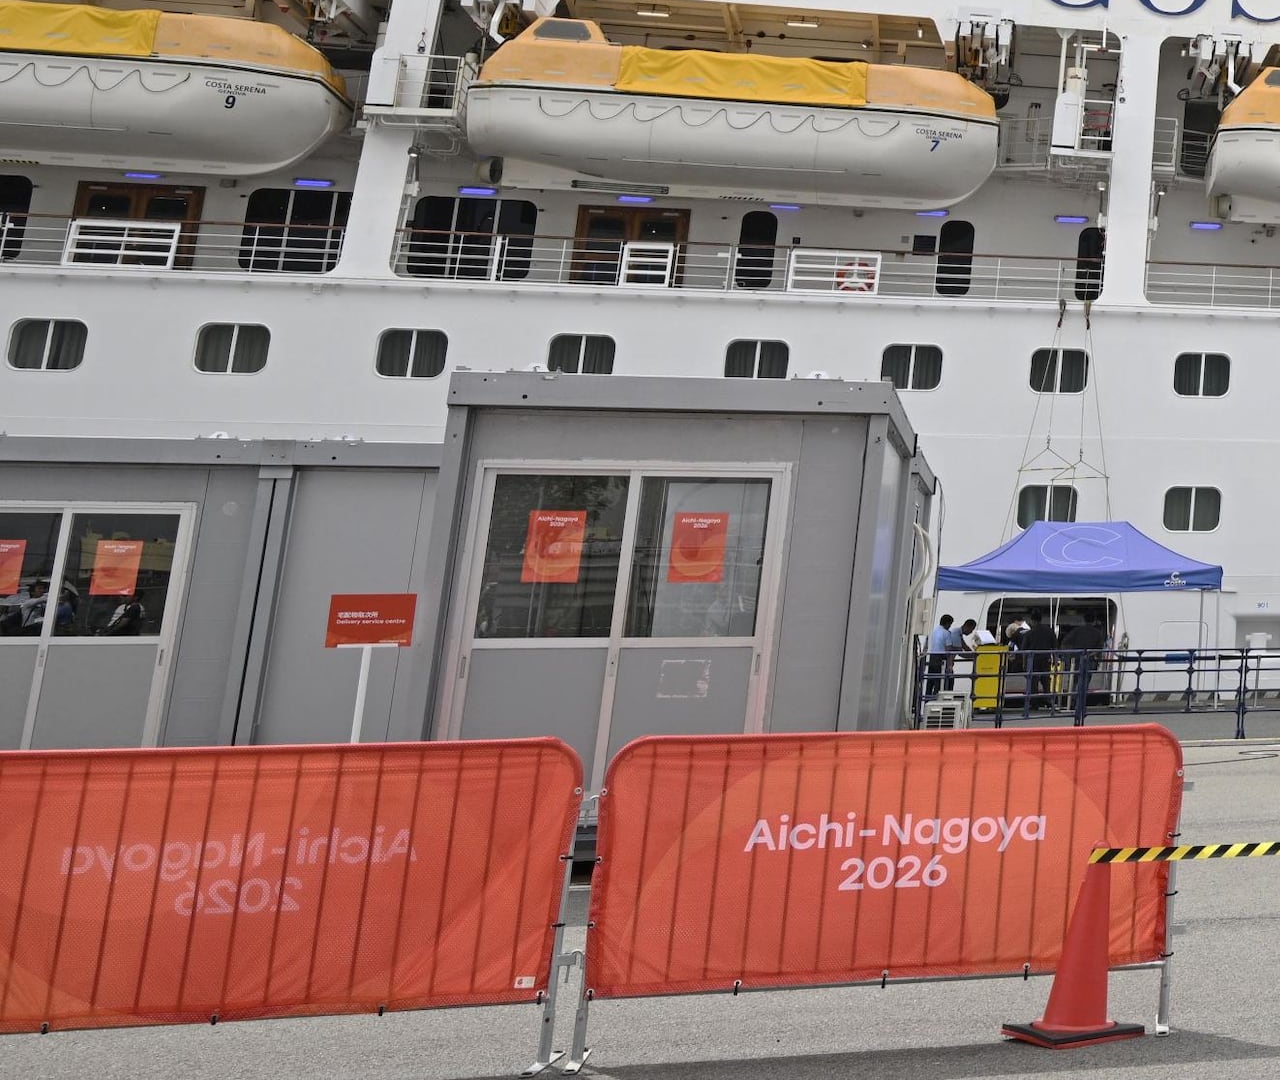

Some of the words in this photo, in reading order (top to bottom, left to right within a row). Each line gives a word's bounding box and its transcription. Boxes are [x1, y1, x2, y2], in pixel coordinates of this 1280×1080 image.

[205, 80, 232, 90] COSTA
[234, 84, 266, 95] SERENA
[224, 95, 236, 109] 9
[915, 128, 937, 136] COSTA
[938, 130, 963, 140] SERENA
[930, 140, 940, 152] 7
[538, 515, 579, 523] Aichi-Nagoya
[1163, 580, 1187, 588] Costa
[745, 812, 1047, 854] Aichi-Nagoya
[838, 855, 948, 891] 2026
